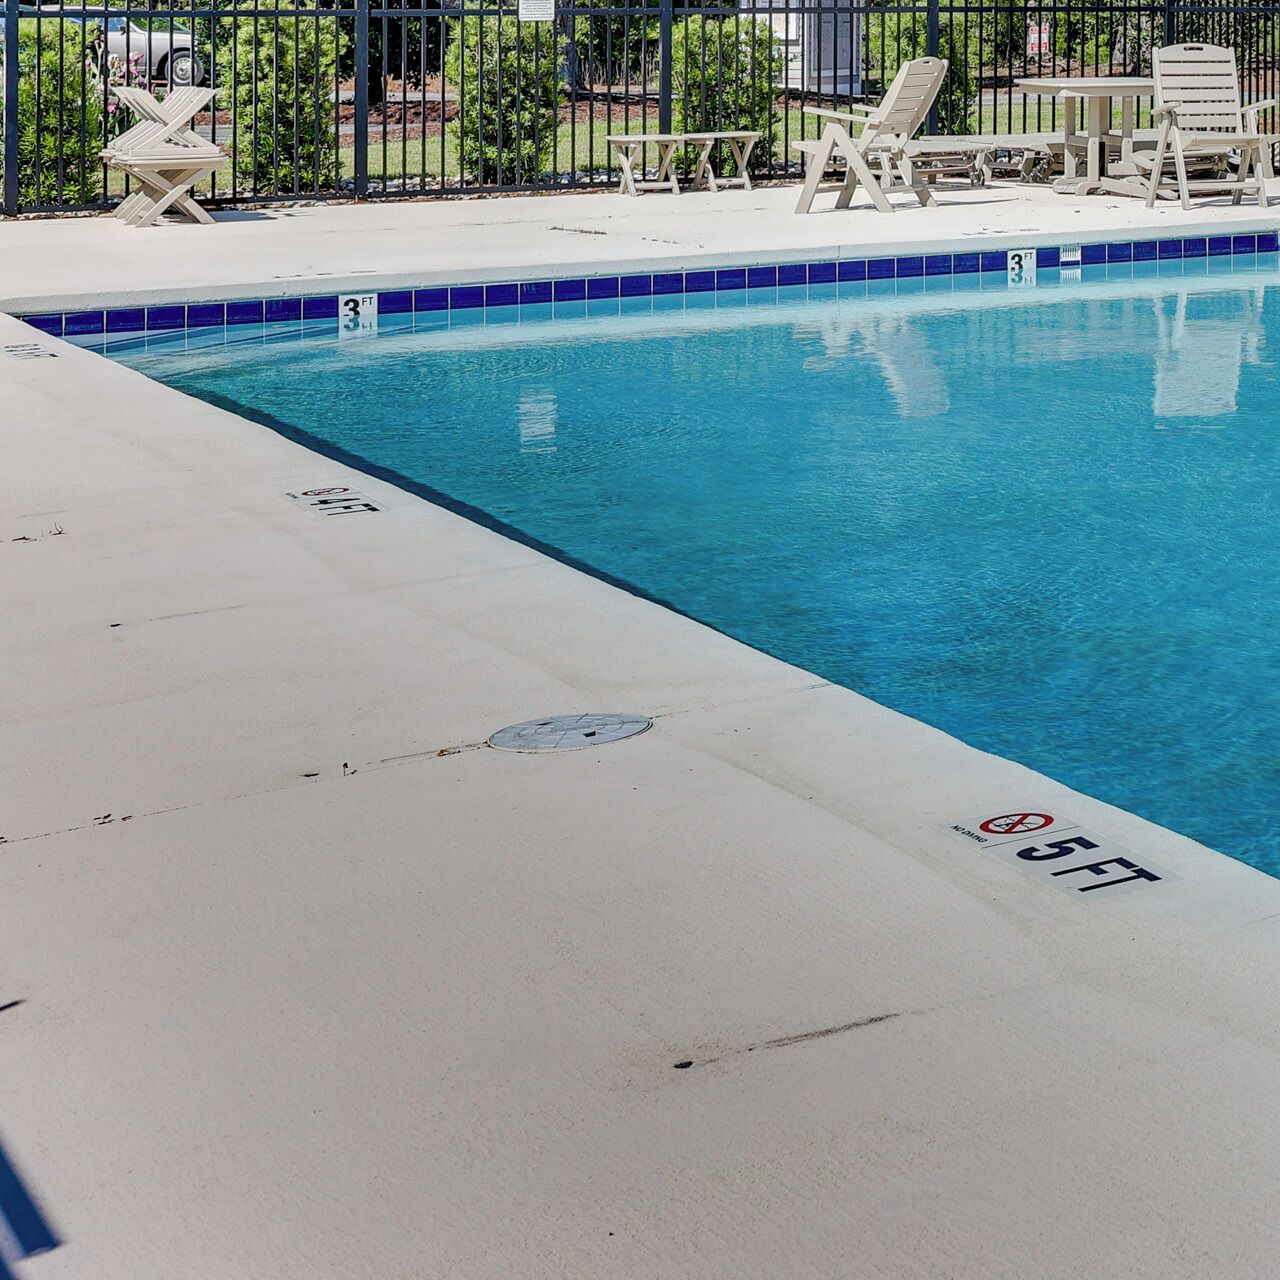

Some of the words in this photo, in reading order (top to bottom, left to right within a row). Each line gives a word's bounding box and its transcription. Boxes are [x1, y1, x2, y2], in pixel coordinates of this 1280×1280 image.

[1011, 253, 1023, 272] 3
[1024, 252, 1033, 260] FT
[343, 298, 360, 317] 3
[362, 296, 374, 306] FT
[310, 498, 360, 506] 4
[318, 503, 381, 516] FT
[951, 825, 965, 835] NO
[962, 829, 989, 843] DIVING
[1016, 836, 1100, 861] 5
[1050, 856, 1163, 893] FT
